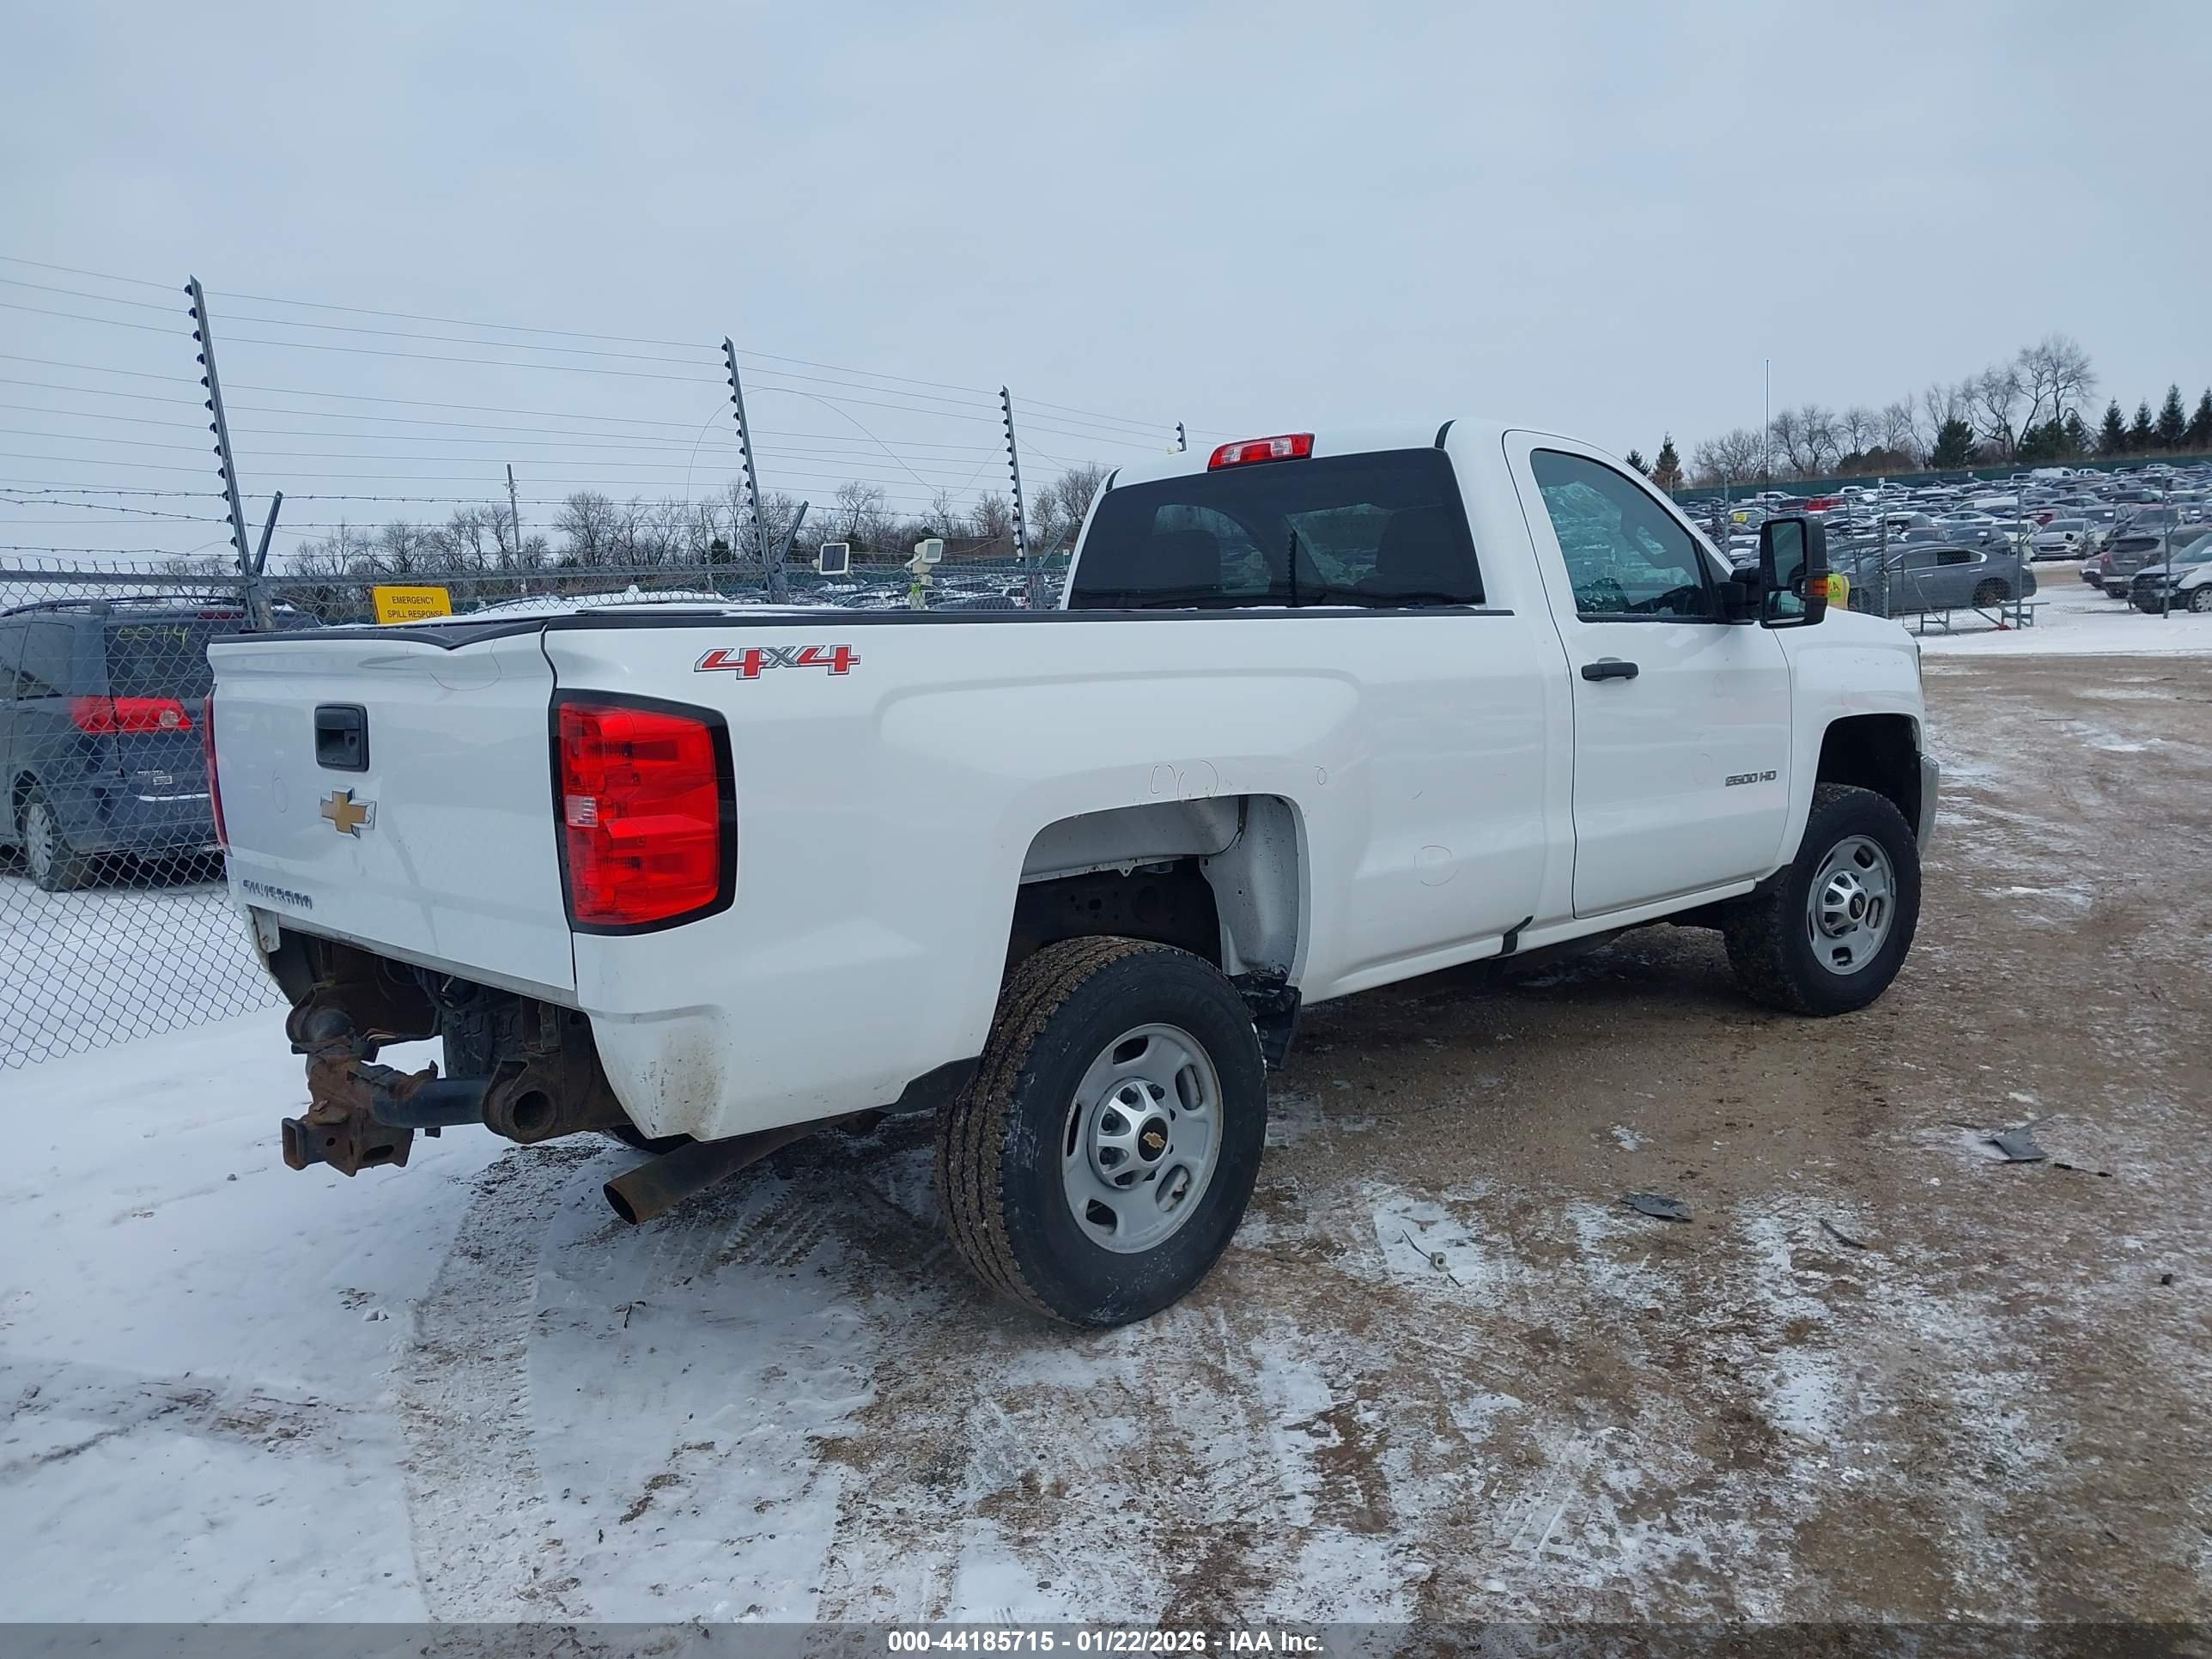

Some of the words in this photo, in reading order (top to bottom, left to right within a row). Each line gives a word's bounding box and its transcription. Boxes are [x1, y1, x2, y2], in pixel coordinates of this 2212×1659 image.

[392, 596, 434, 605] EMERGENCY
[387, 610, 406, 618] SPILL
[408, 610, 444, 619] RESPONSE
[1725, 773, 1758, 787] 2500
[1759, 770, 1777, 781] HD
